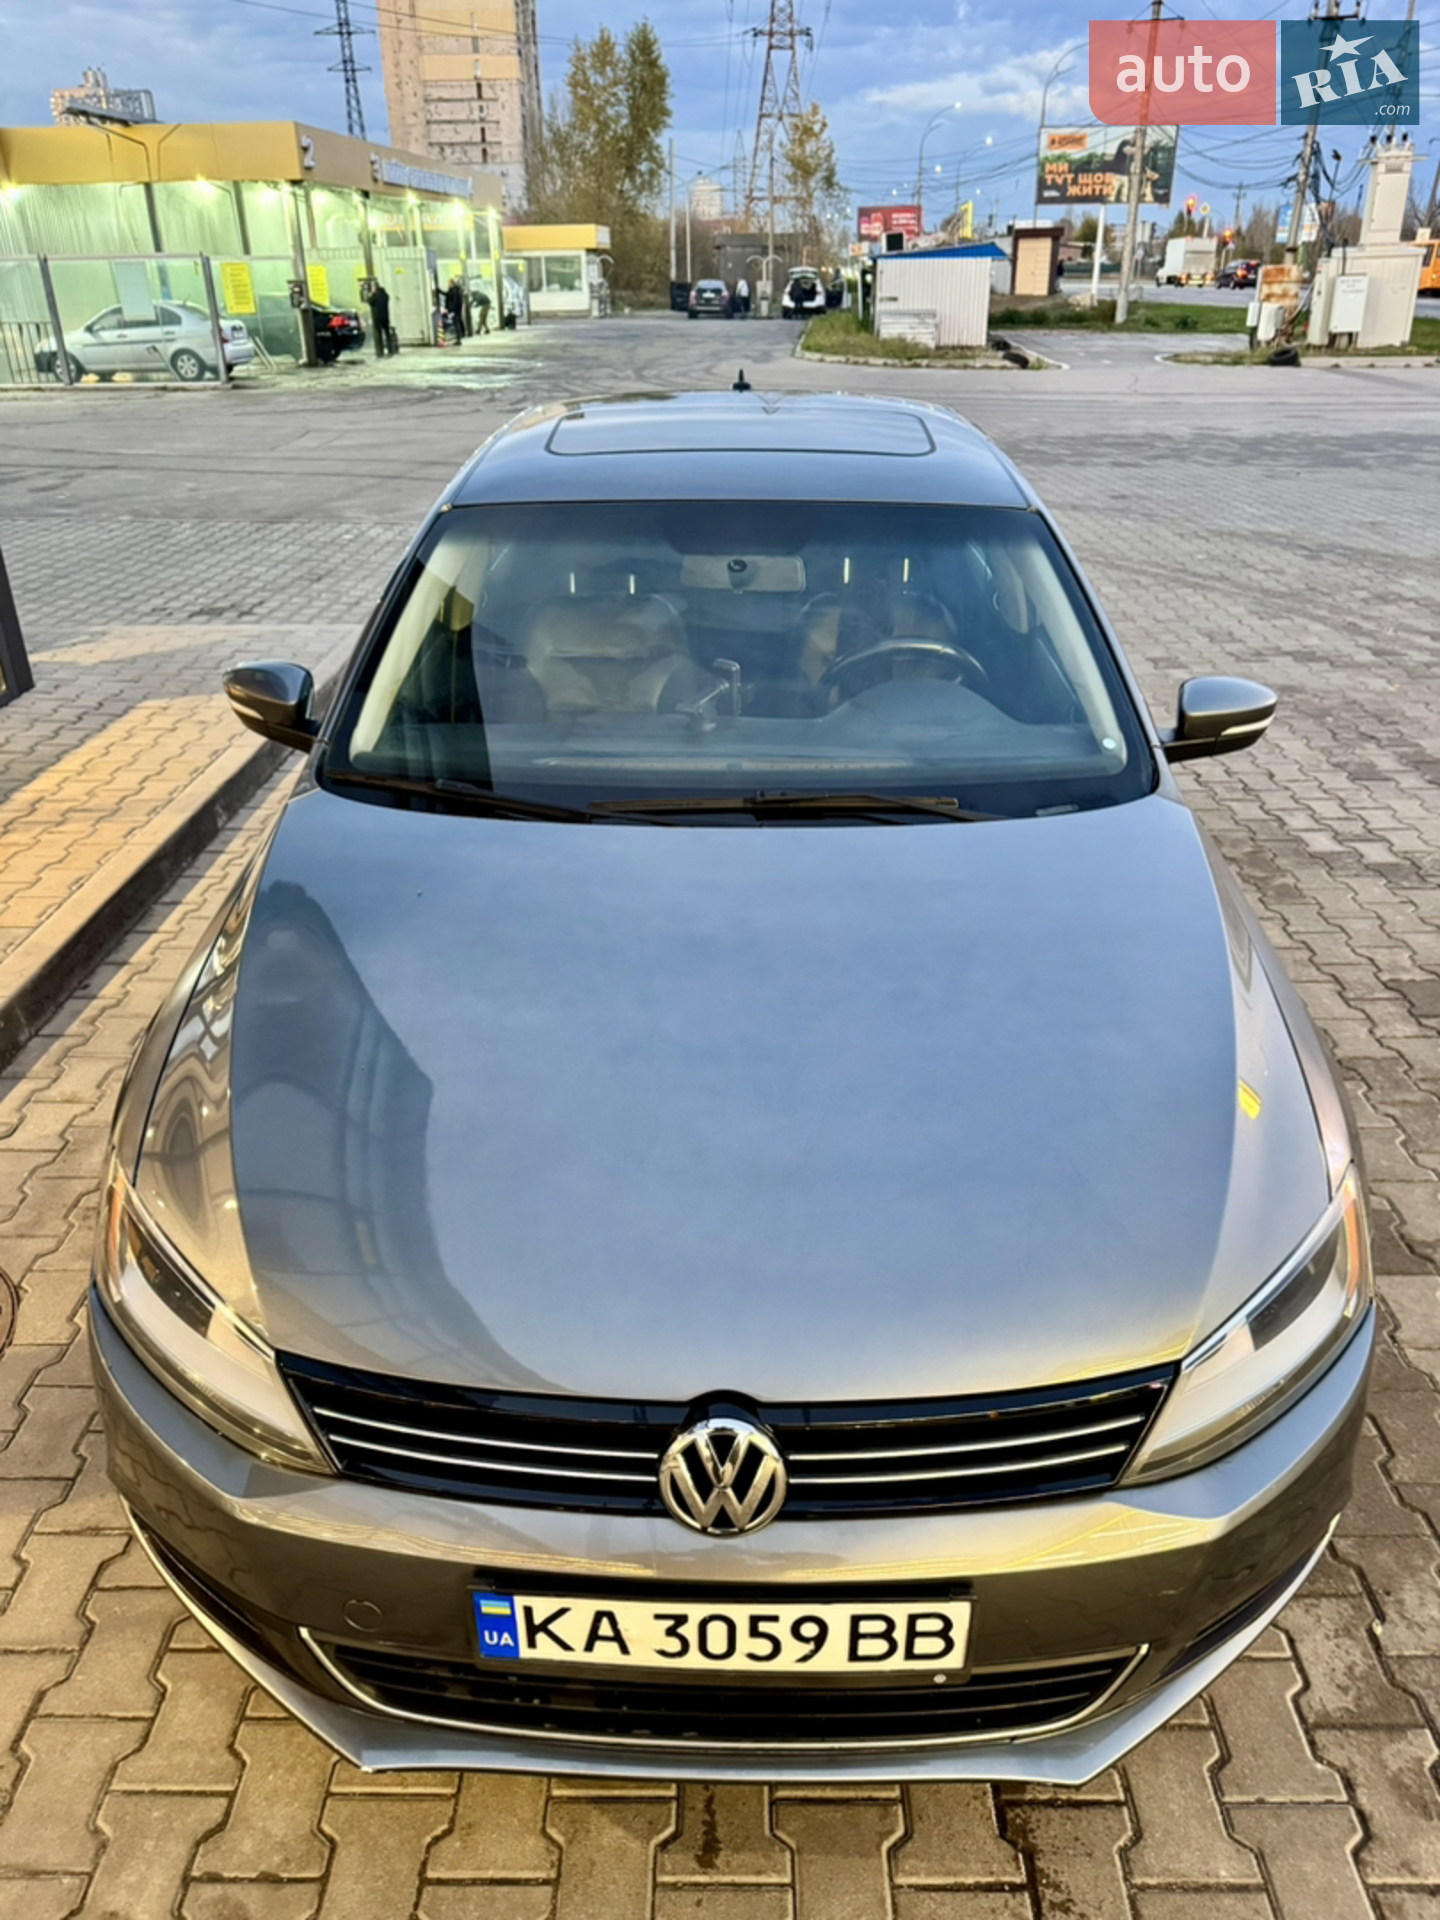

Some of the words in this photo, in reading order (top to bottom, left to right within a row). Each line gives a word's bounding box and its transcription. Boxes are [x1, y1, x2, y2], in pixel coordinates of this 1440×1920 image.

[1045, 163, 1069, 173] МИ
[483, 1629, 515, 1648] UA
[522, 1604, 632, 1657] KA
[653, 1612, 830, 1664] 3059
[848, 1610, 956, 1663] BB
